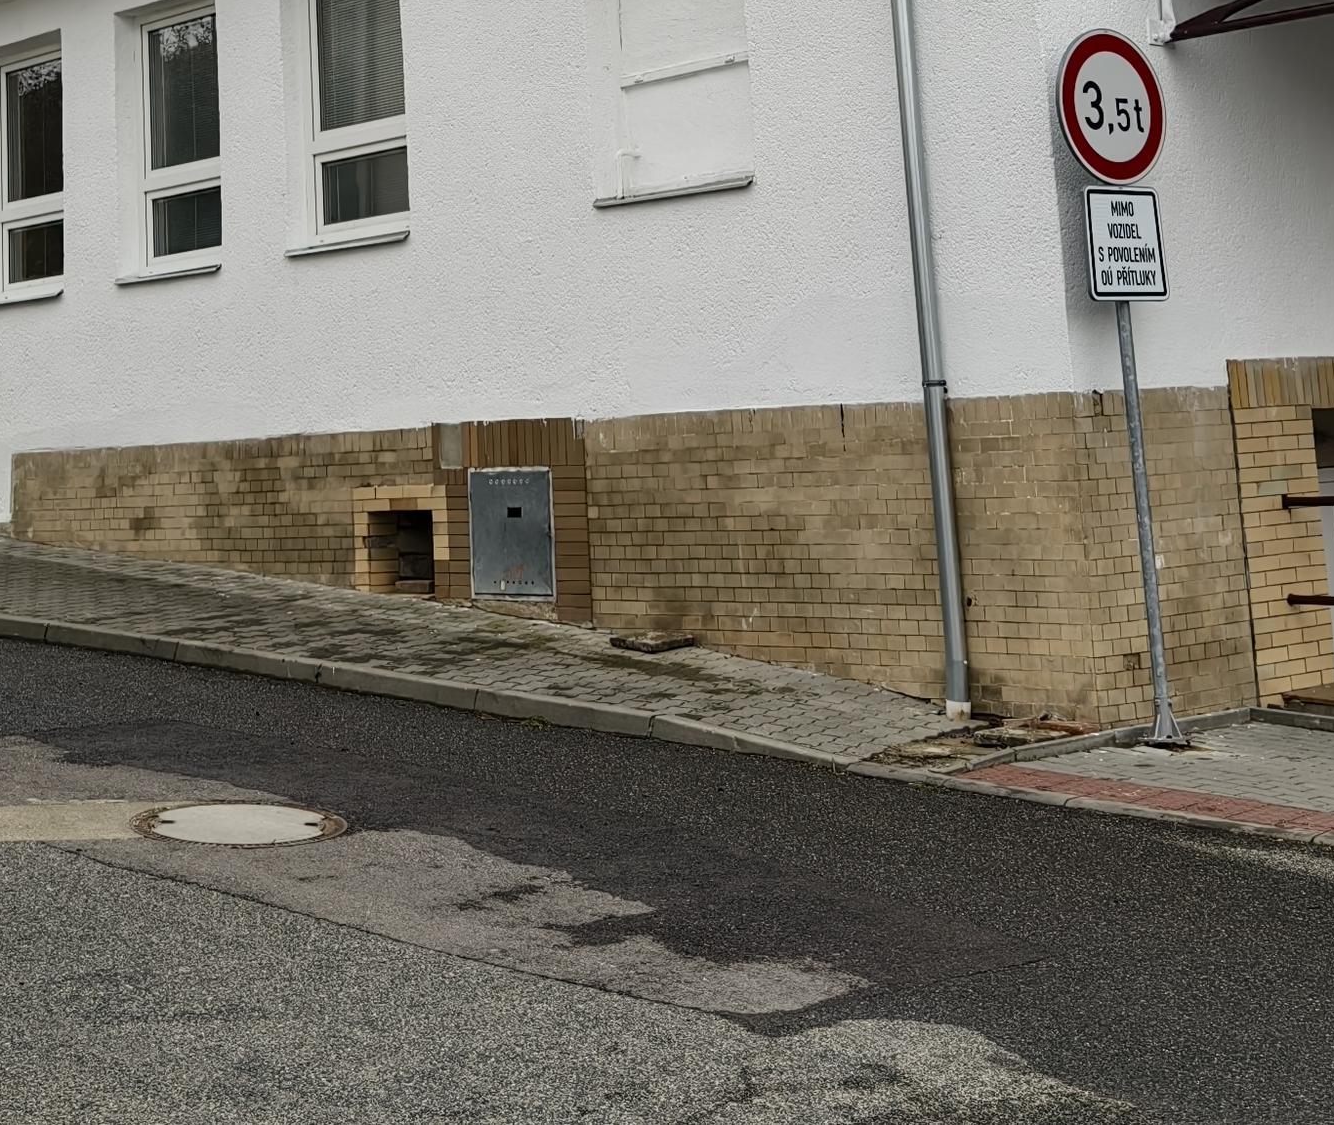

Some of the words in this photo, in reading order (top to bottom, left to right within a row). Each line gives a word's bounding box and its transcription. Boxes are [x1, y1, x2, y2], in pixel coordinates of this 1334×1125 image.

[1110, 200, 1134, 217] MIMO
[1107, 223, 1142, 239] VOZIDEL
[1098, 246, 1104, 262] S
[1107, 243, 1156, 263] POVOLENÍM
[1101, 266, 1113, 286] OÚ
[1117, 266, 1156, 286] PŘÍTLUKY
